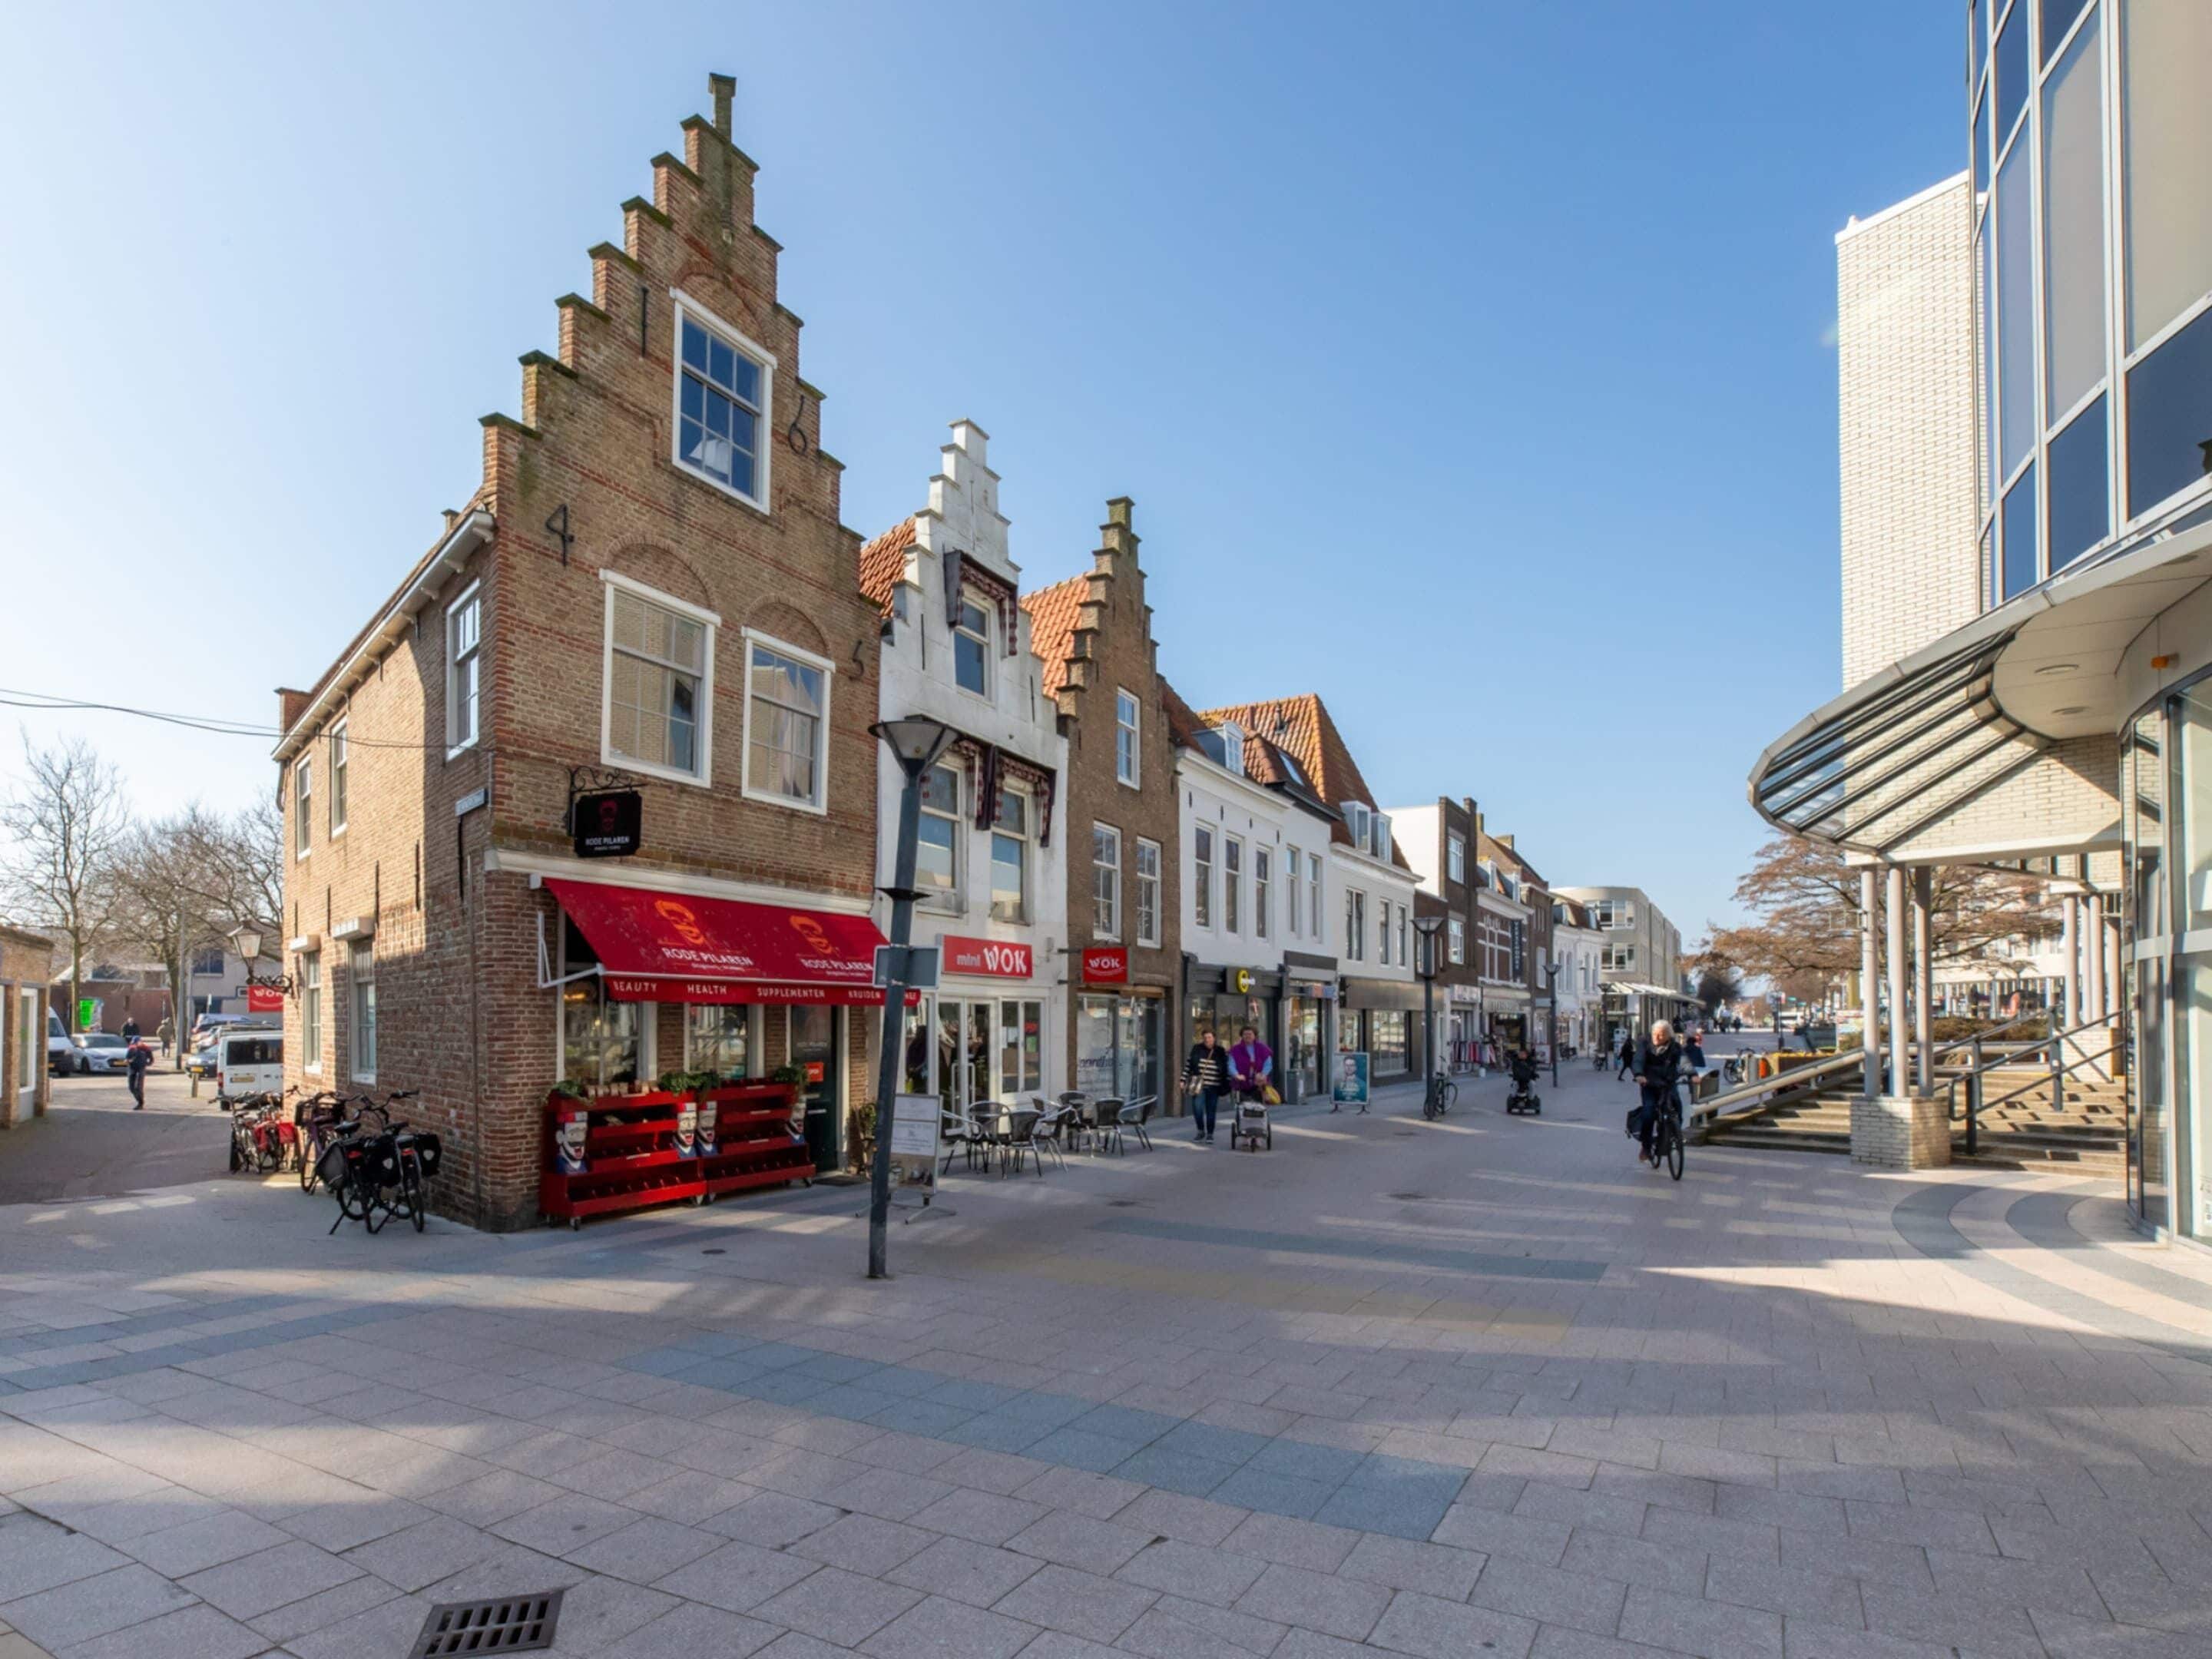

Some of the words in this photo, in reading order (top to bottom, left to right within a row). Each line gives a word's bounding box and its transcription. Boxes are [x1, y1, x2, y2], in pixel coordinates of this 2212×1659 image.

[661, 947, 700, 961] RODE
[700, 952, 754, 965] PILAREN
[800, 959, 832, 969] RODE
[956, 952, 981, 966] mini
[983, 945, 1027, 974] WOK
[1088, 957, 1120, 969] WOK
[613, 981, 657, 992] BEAUTY
[687, 984, 727, 995] HEALTH
[757, 987, 825, 998] SUPPLEMENTEN
[848, 989, 881, 998] KRUIDEN
